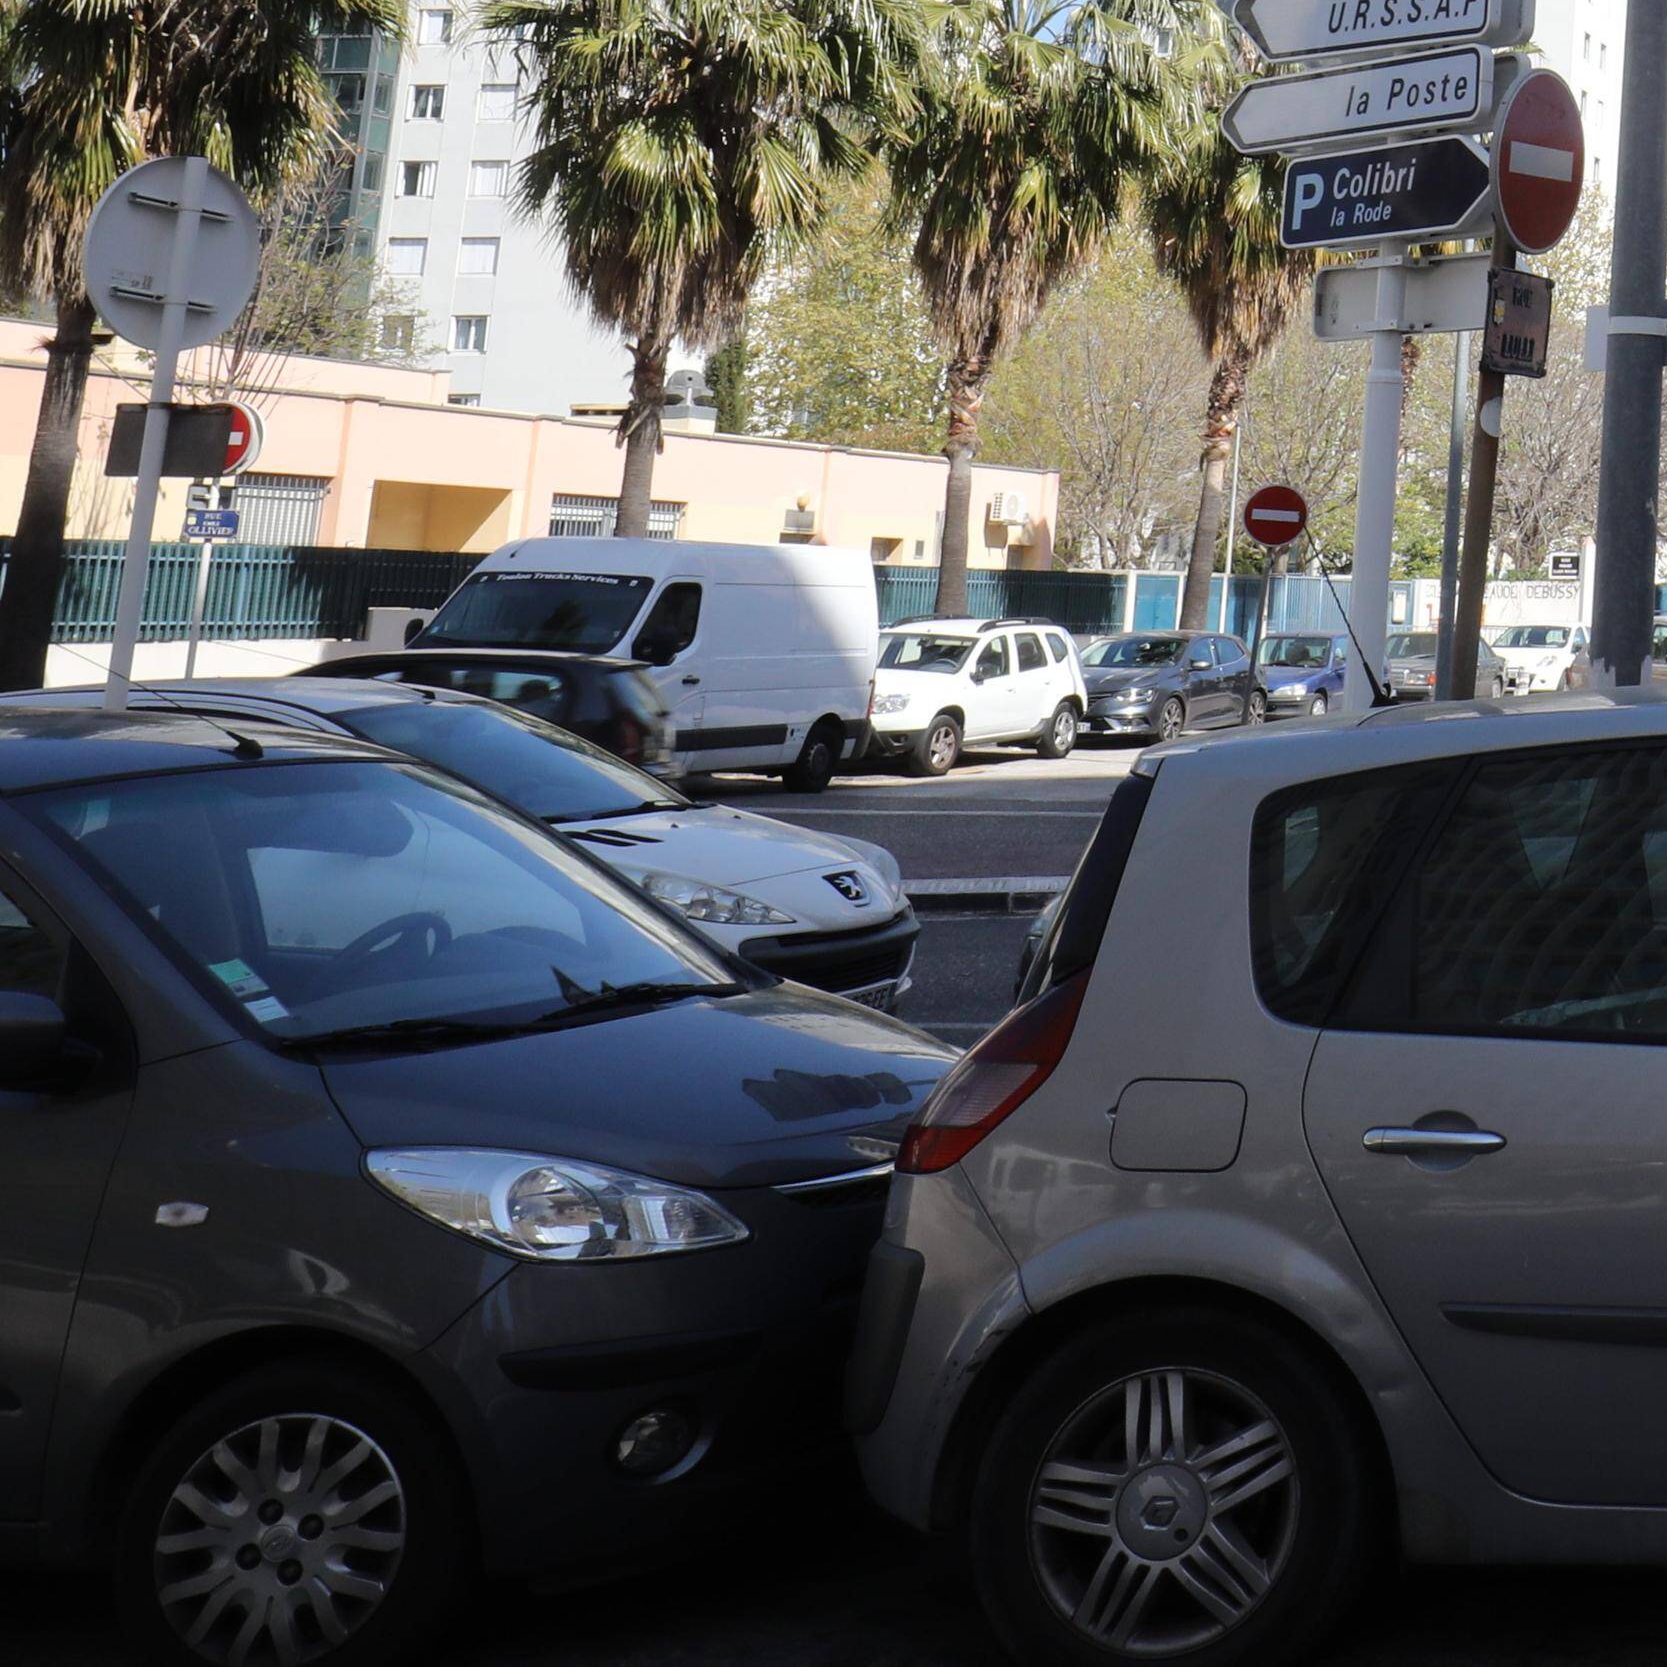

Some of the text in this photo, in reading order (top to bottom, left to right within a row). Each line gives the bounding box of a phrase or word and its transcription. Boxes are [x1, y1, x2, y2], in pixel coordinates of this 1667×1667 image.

[1345, 73, 1468, 117] la Poste
[1291, 157, 1416, 231] P Colibri
[1330, 202, 1392, 228] la Rode
[571, 573, 619, 585] Services
[1527, 585, 1580, 599] DEBUSSY
